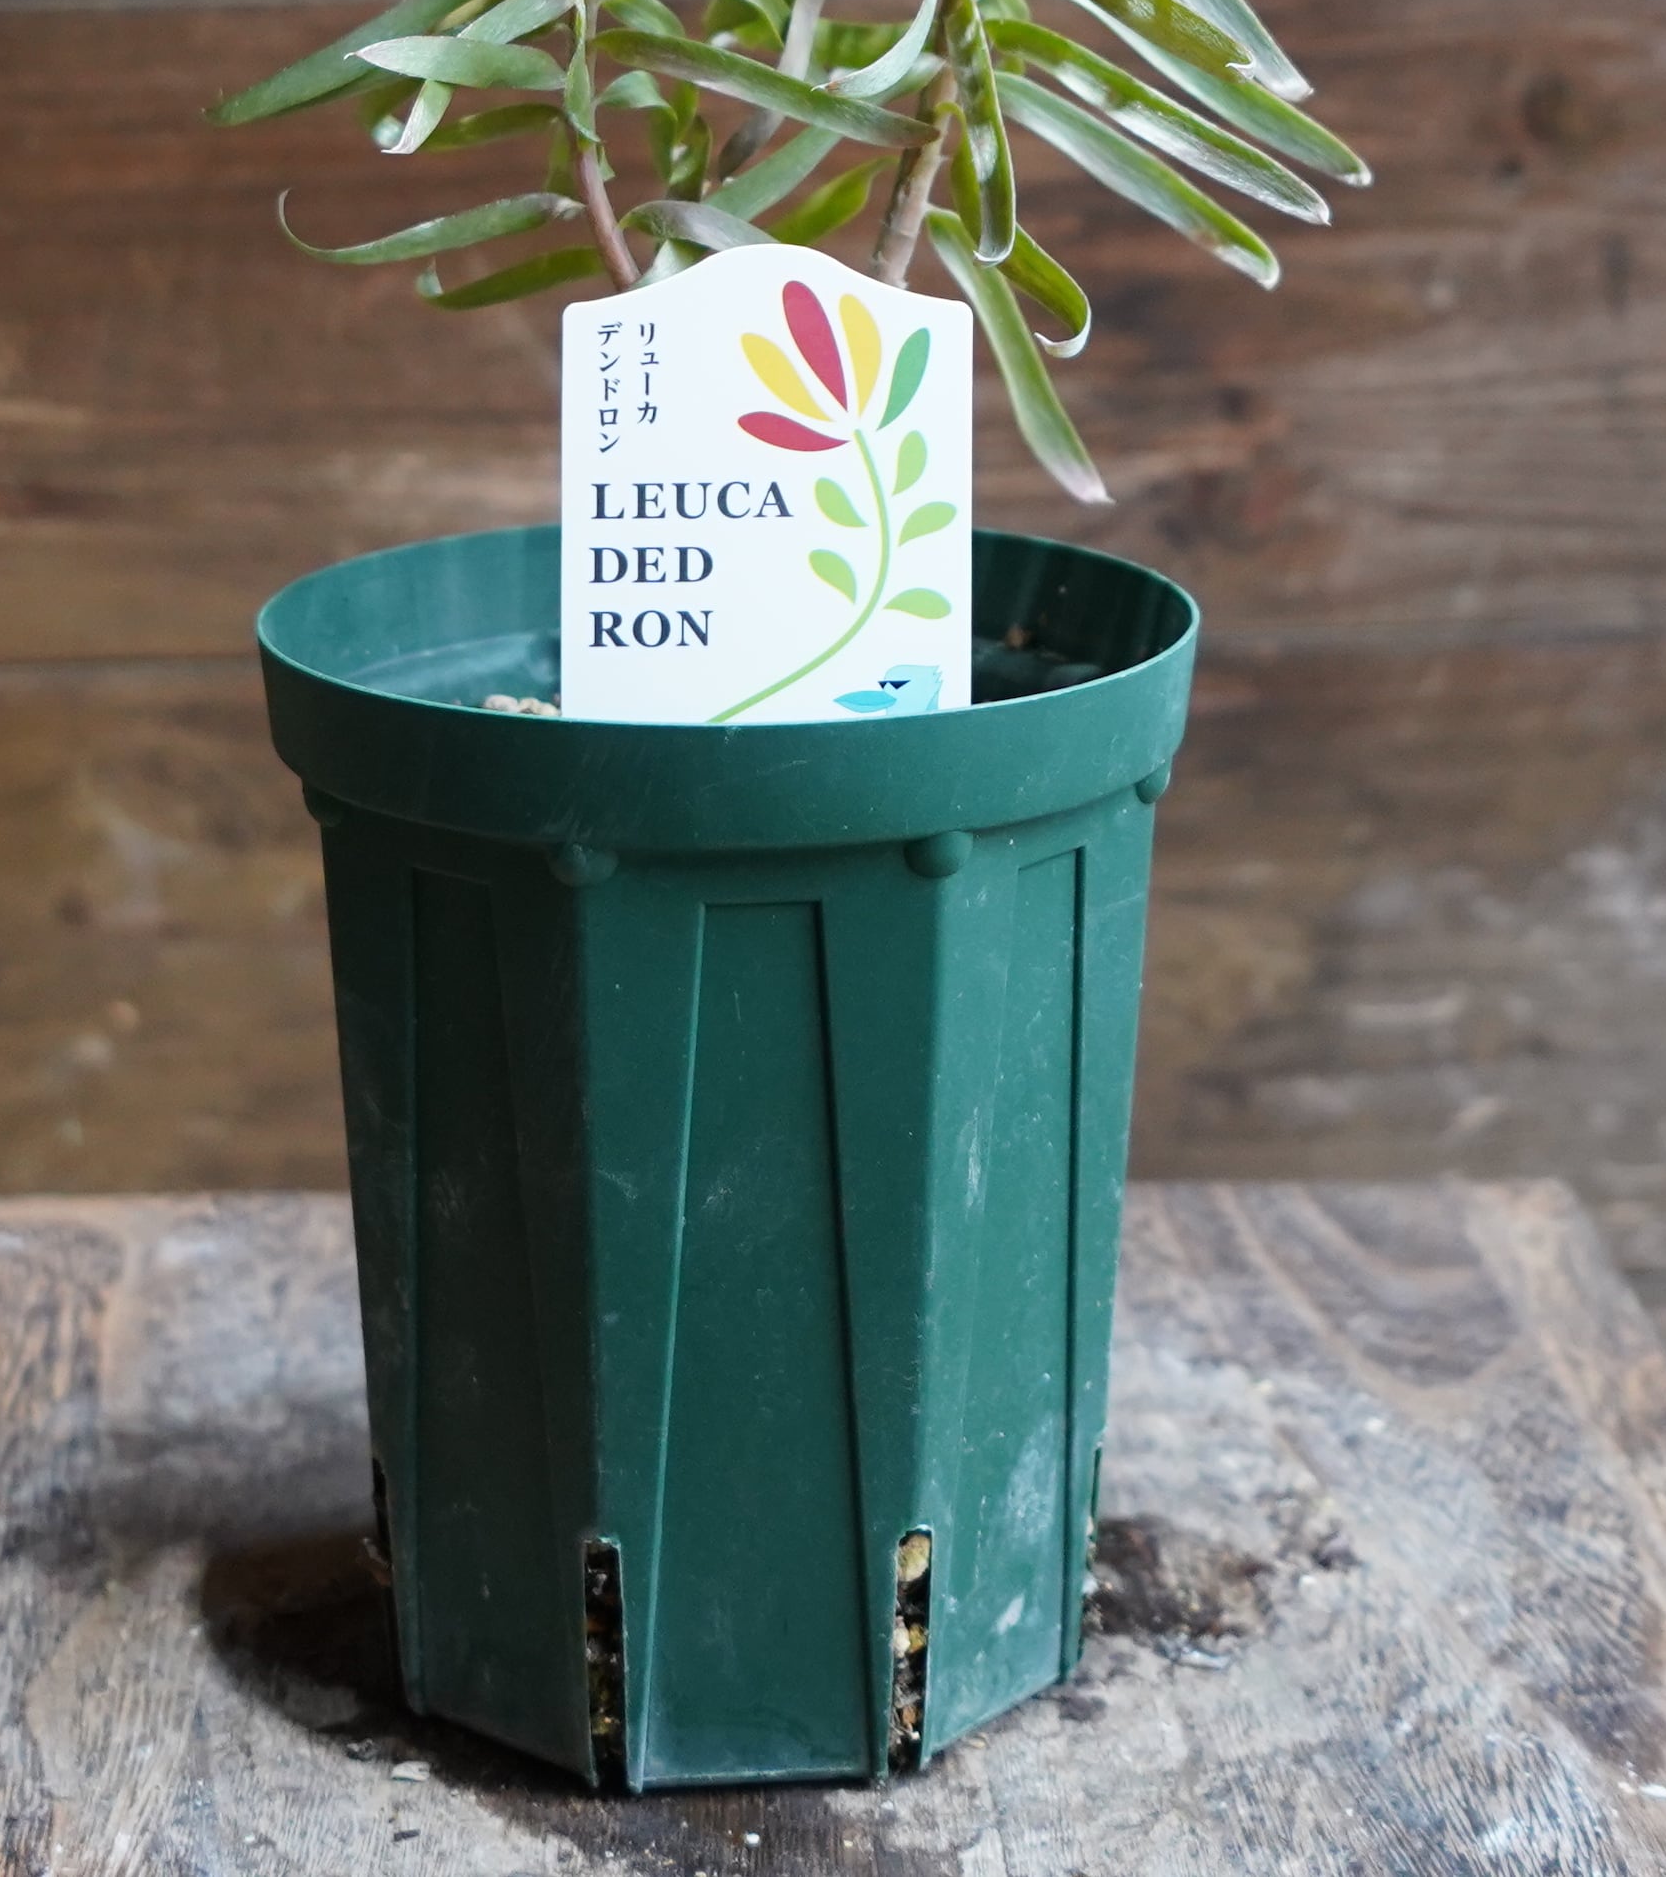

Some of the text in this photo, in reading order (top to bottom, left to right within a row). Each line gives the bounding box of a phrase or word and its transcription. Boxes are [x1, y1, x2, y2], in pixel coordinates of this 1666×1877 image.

[597, 321, 623, 453] デンドロン
[637, 322, 660, 424] リューカ
[591, 481, 794, 520] LEUCA
[588, 546, 714, 584] DED
[588, 609, 714, 648] RON
